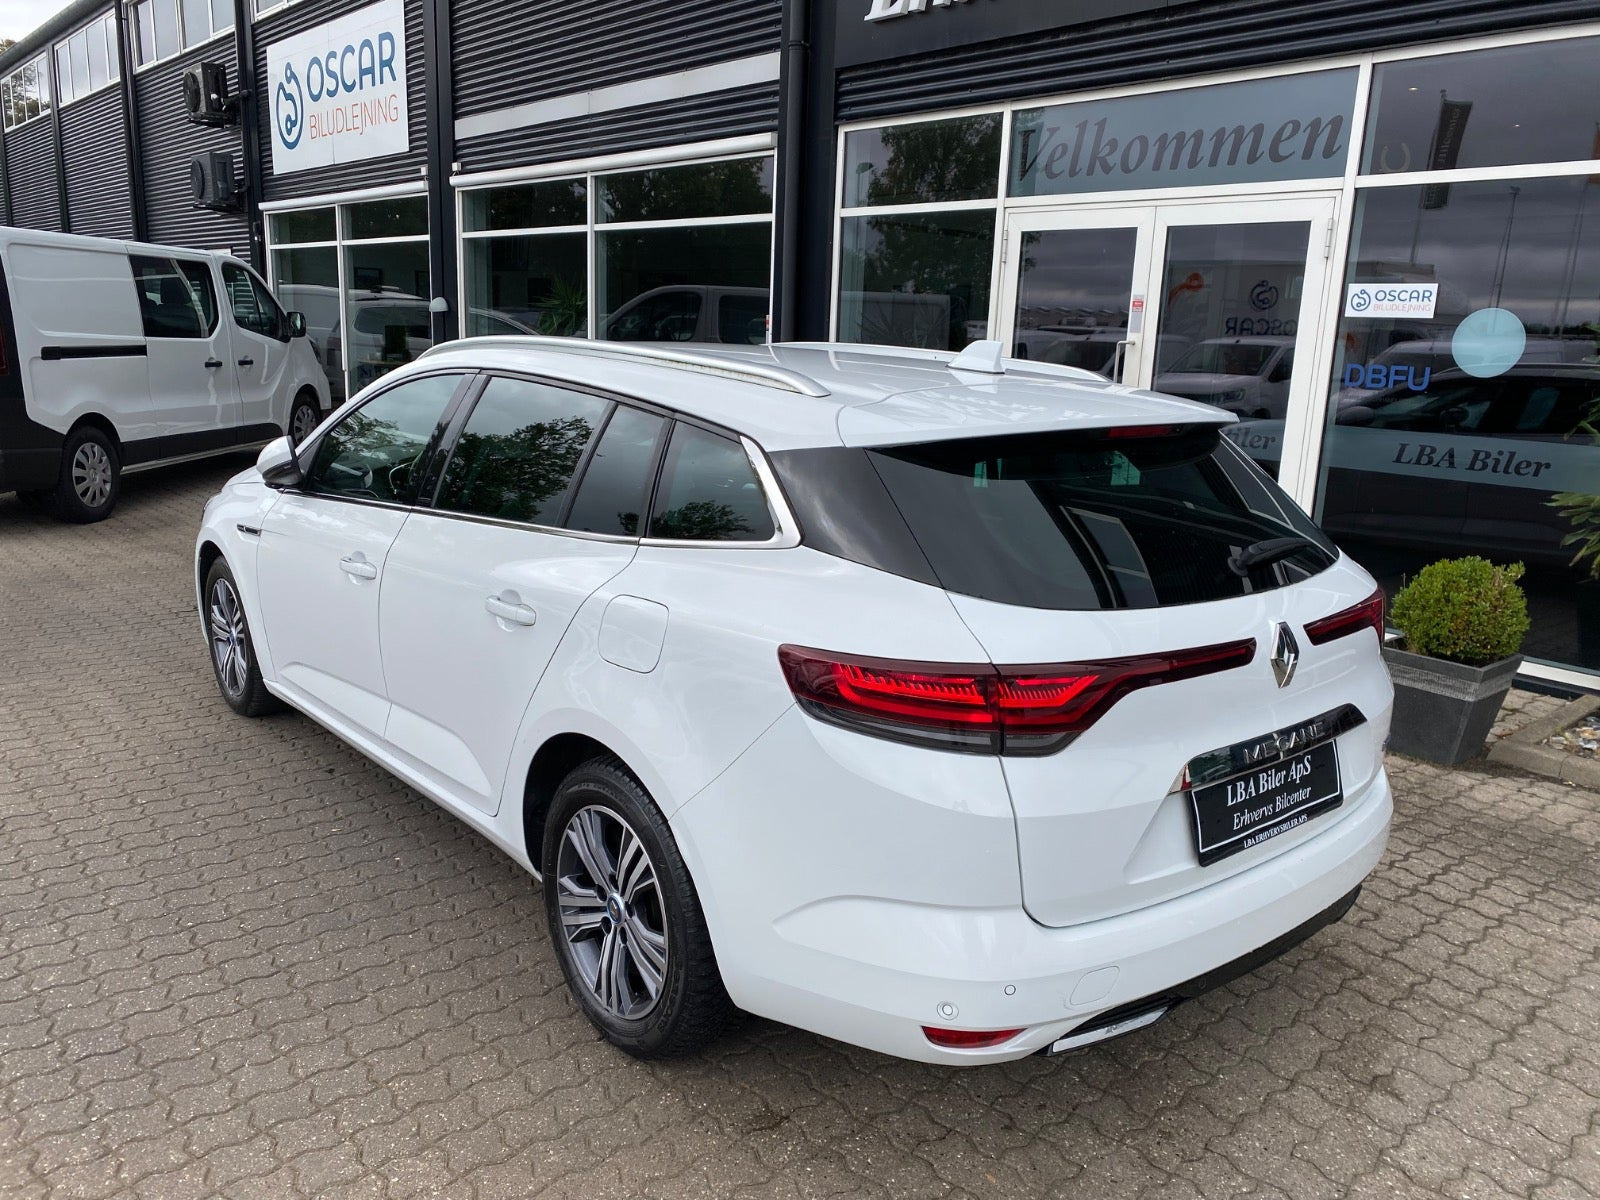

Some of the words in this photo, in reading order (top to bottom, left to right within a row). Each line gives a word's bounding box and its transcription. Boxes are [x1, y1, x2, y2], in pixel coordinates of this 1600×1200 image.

[306, 31, 397, 102] OSCAR
[309, 94, 399, 139] BILUDLEJNING
[1017, 114, 1344, 182] Velkommen
[1373, 303, 1431, 312] BILUDLEJNING
[1375, 289, 1433, 302] OSCAR
[1343, 363, 1431, 391] DBFU
[1392, 443, 1456, 468] LBA
[1465, 449, 1552, 477] Biler
[1244, 721, 1326, 764] MEGANE
[1226, 776, 1257, 807] LBA
[1258, 769, 1287, 794] Biler
[1288, 755, 1312, 784] ApS
[1233, 804, 1273, 830] Erhvervs
[1275, 786, 1312, 813] Bilcenter
[1243, 837, 1257, 848] LBA
